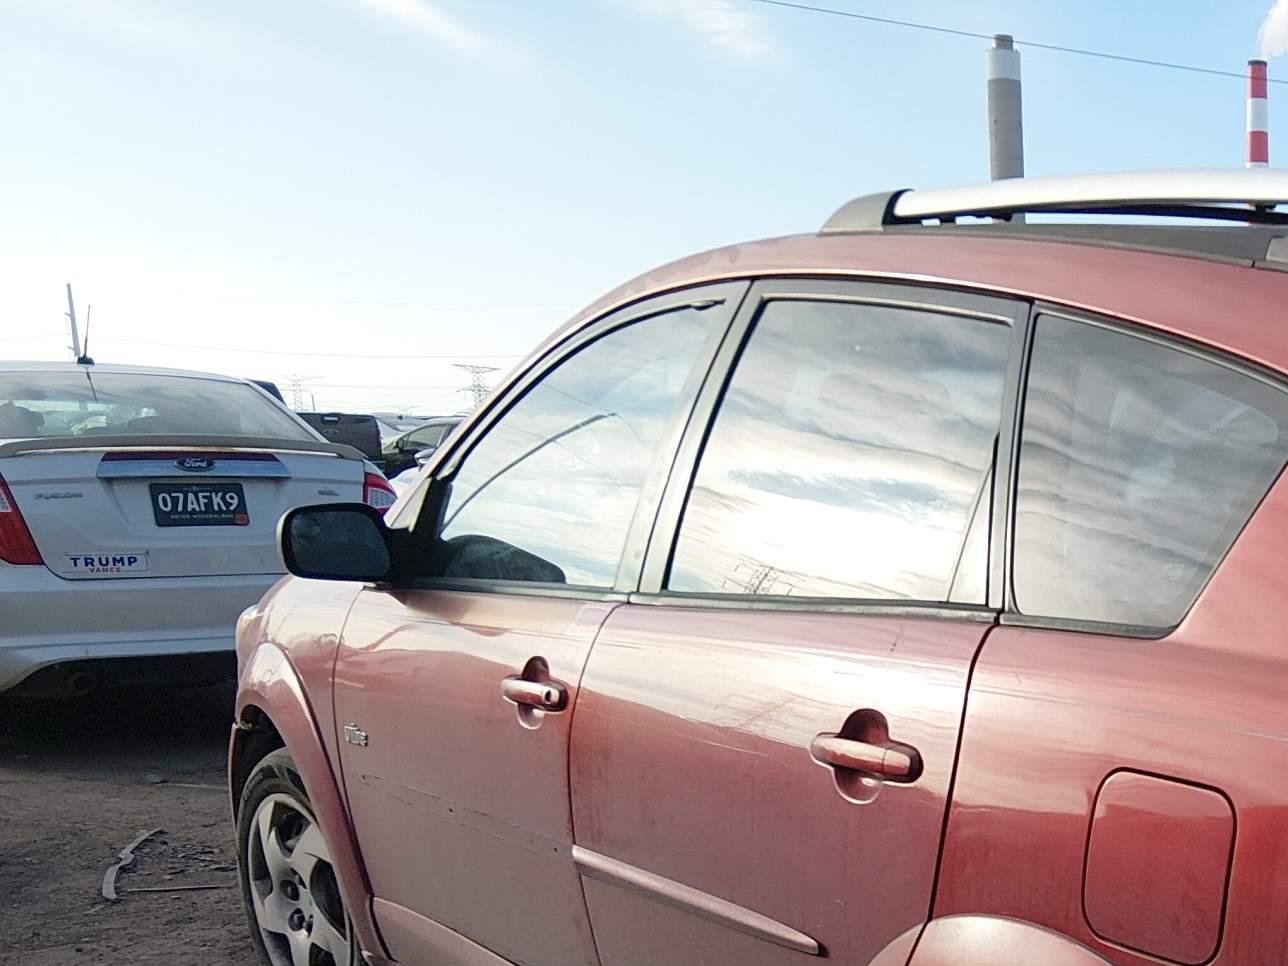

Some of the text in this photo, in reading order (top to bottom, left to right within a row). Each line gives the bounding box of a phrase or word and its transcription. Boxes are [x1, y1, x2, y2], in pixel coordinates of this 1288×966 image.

[183, 458, 207, 468] Ford
[157, 492, 240, 512] 07AFK9
[69, 556, 138, 567] TRUMP
